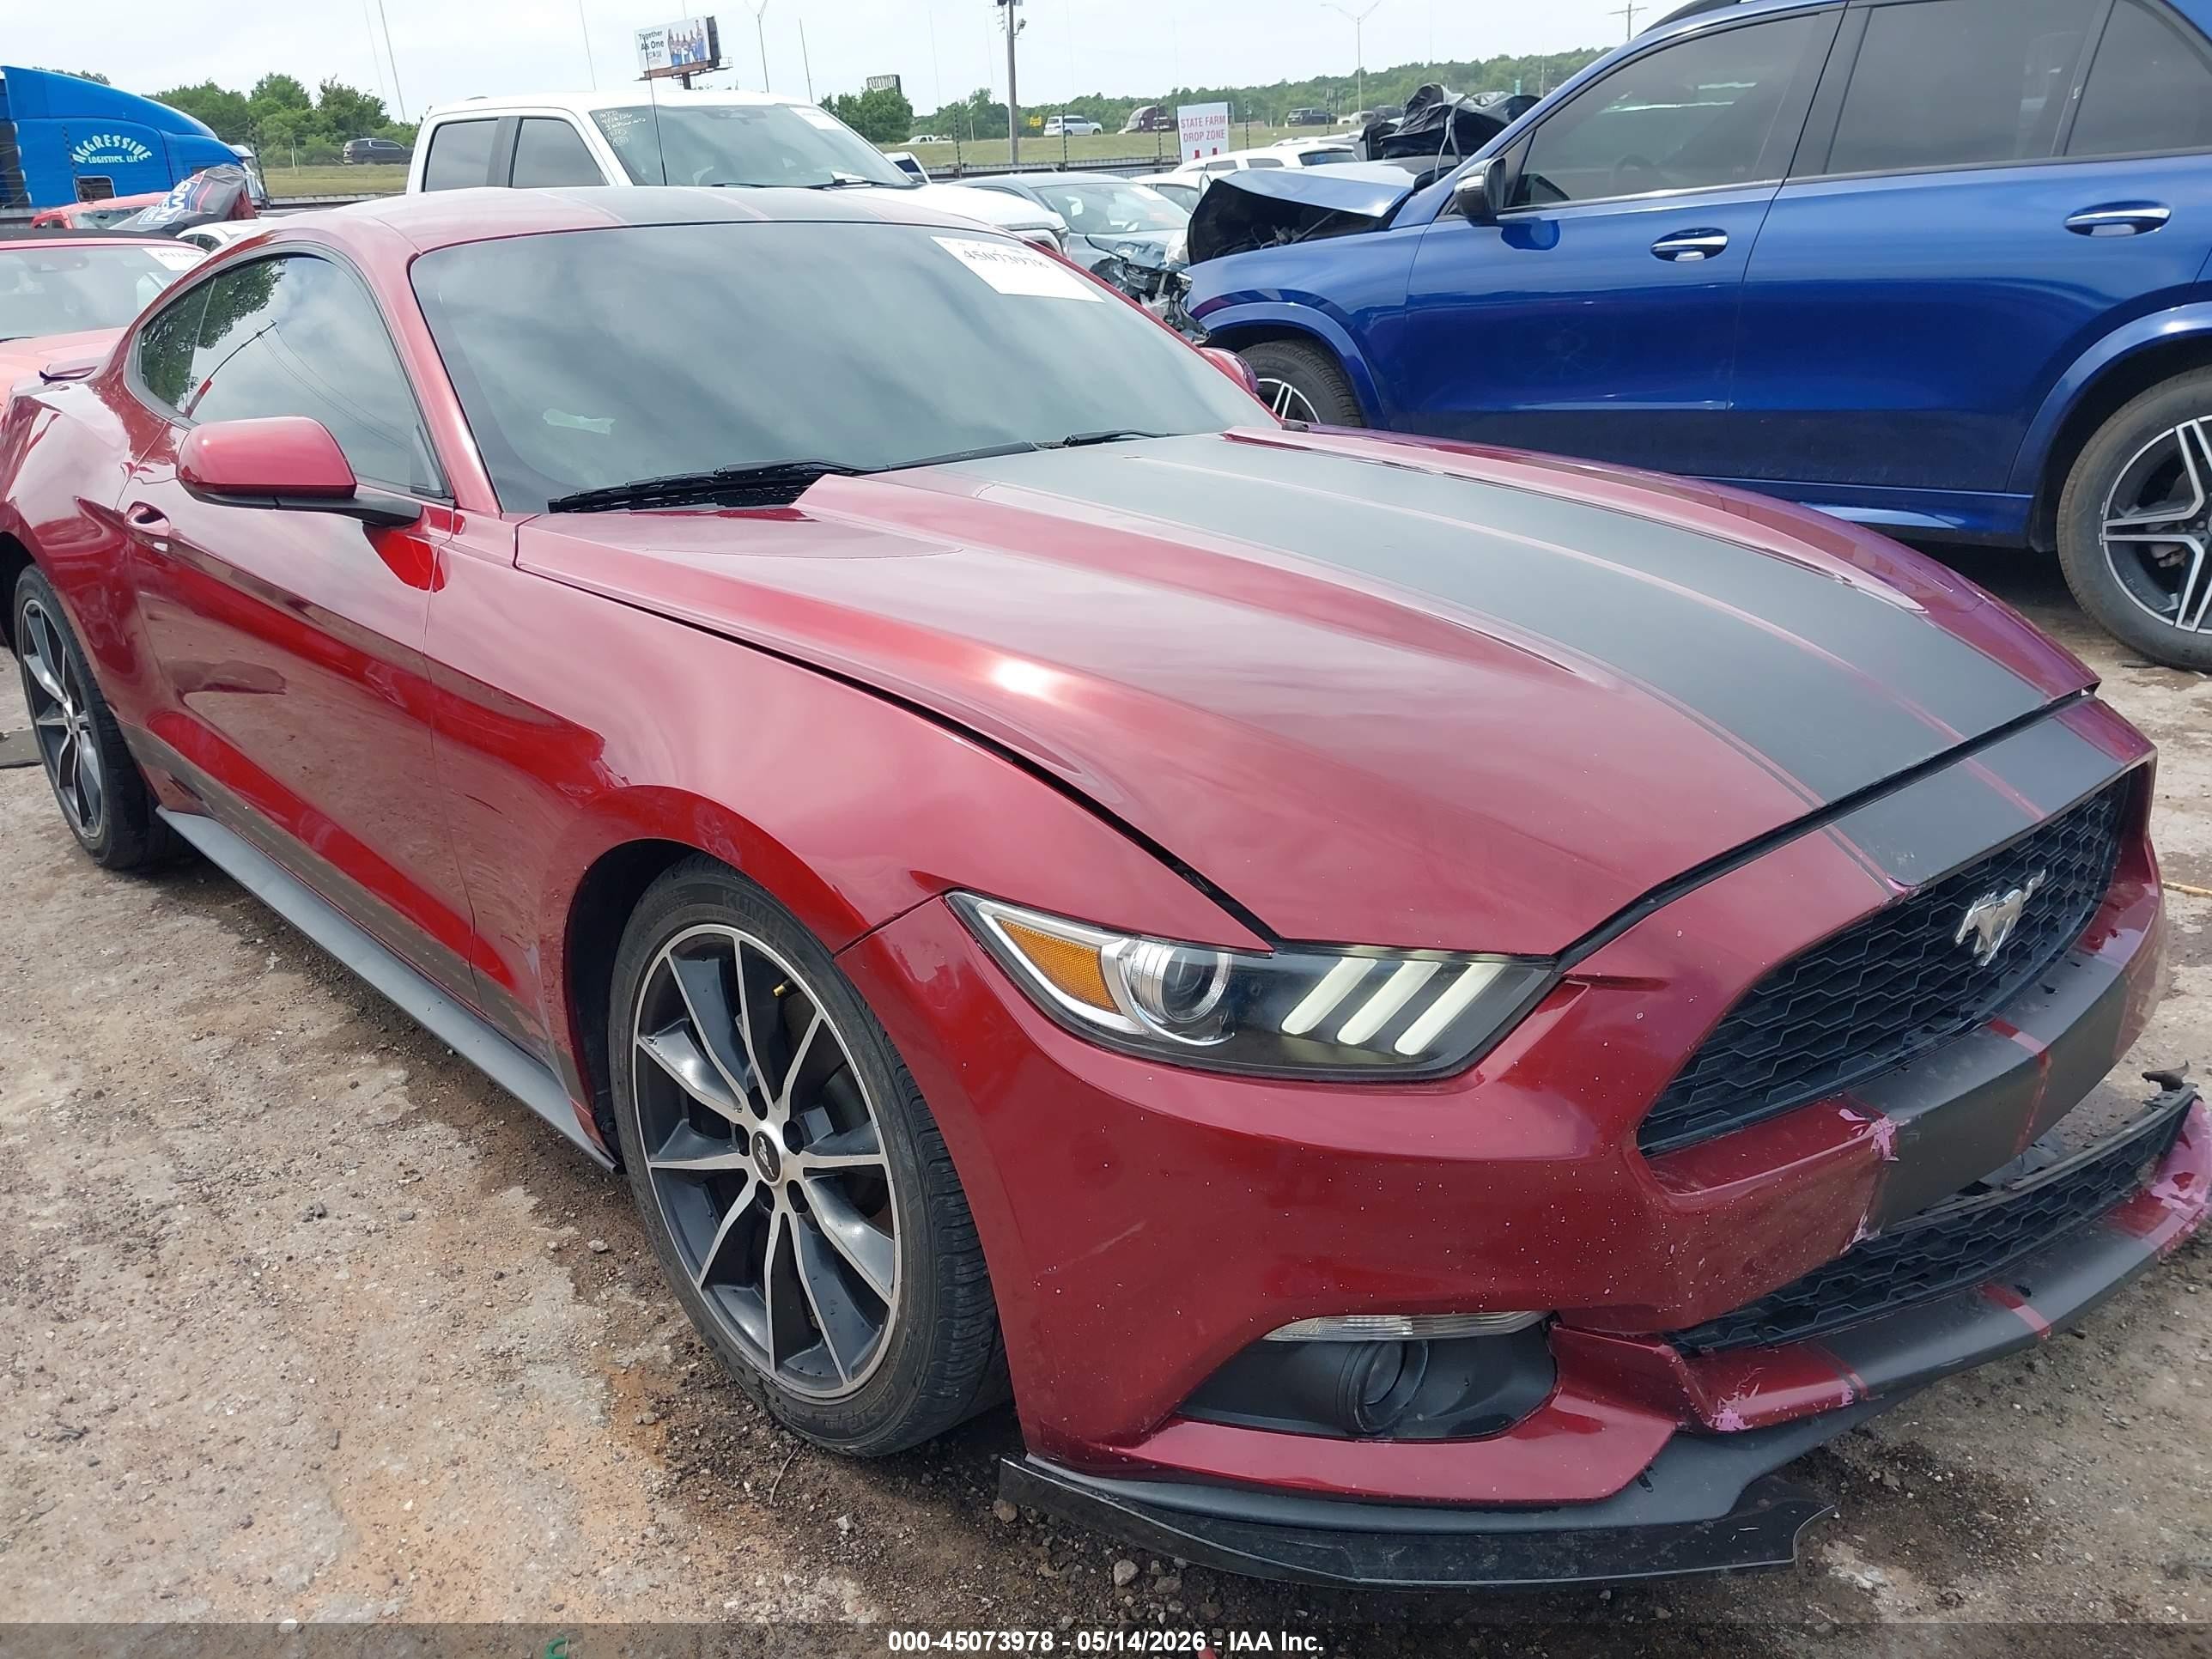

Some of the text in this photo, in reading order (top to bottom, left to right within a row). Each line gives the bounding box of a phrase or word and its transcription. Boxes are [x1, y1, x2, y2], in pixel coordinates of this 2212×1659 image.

[638, 30, 663, 40] Together
[651, 40, 665, 49] One
[1181, 115, 1226, 129] STATE FARM
[1183, 129, 1224, 143] DROP ZONE
[72, 134, 153, 164] AGGRESSIVE
